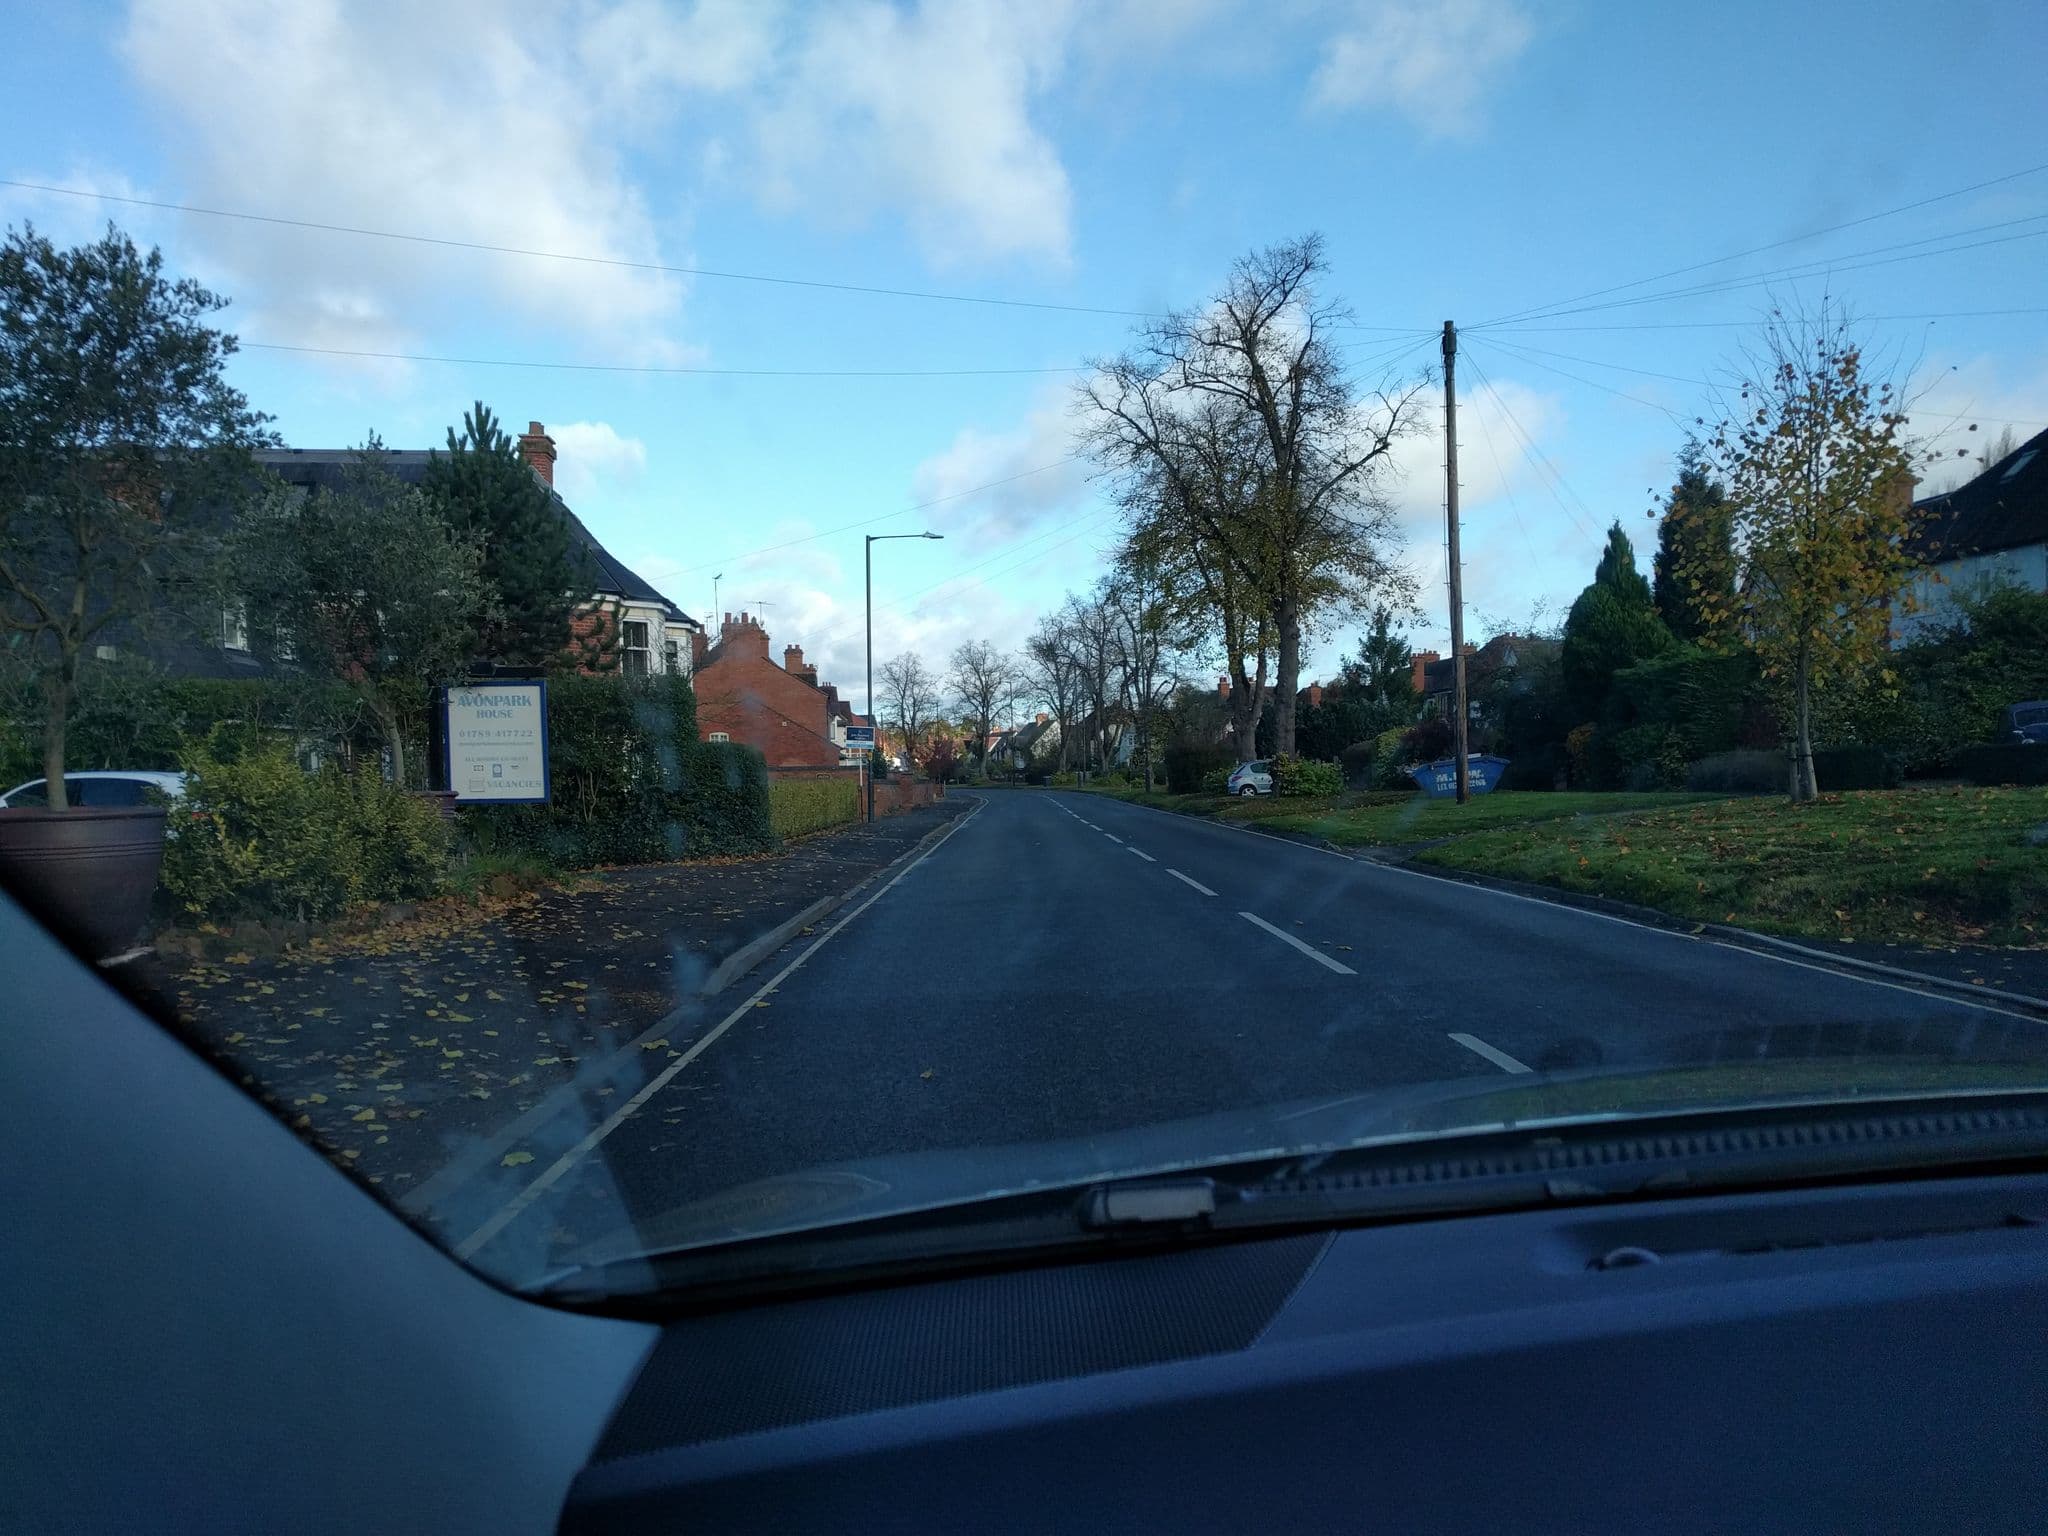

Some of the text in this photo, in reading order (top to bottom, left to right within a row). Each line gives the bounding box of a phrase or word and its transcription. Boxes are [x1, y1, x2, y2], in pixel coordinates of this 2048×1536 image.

[458, 695, 532, 706] AVONPARK
[477, 709, 512, 719] HOUSE
[487, 780, 541, 788] VACANCIES
